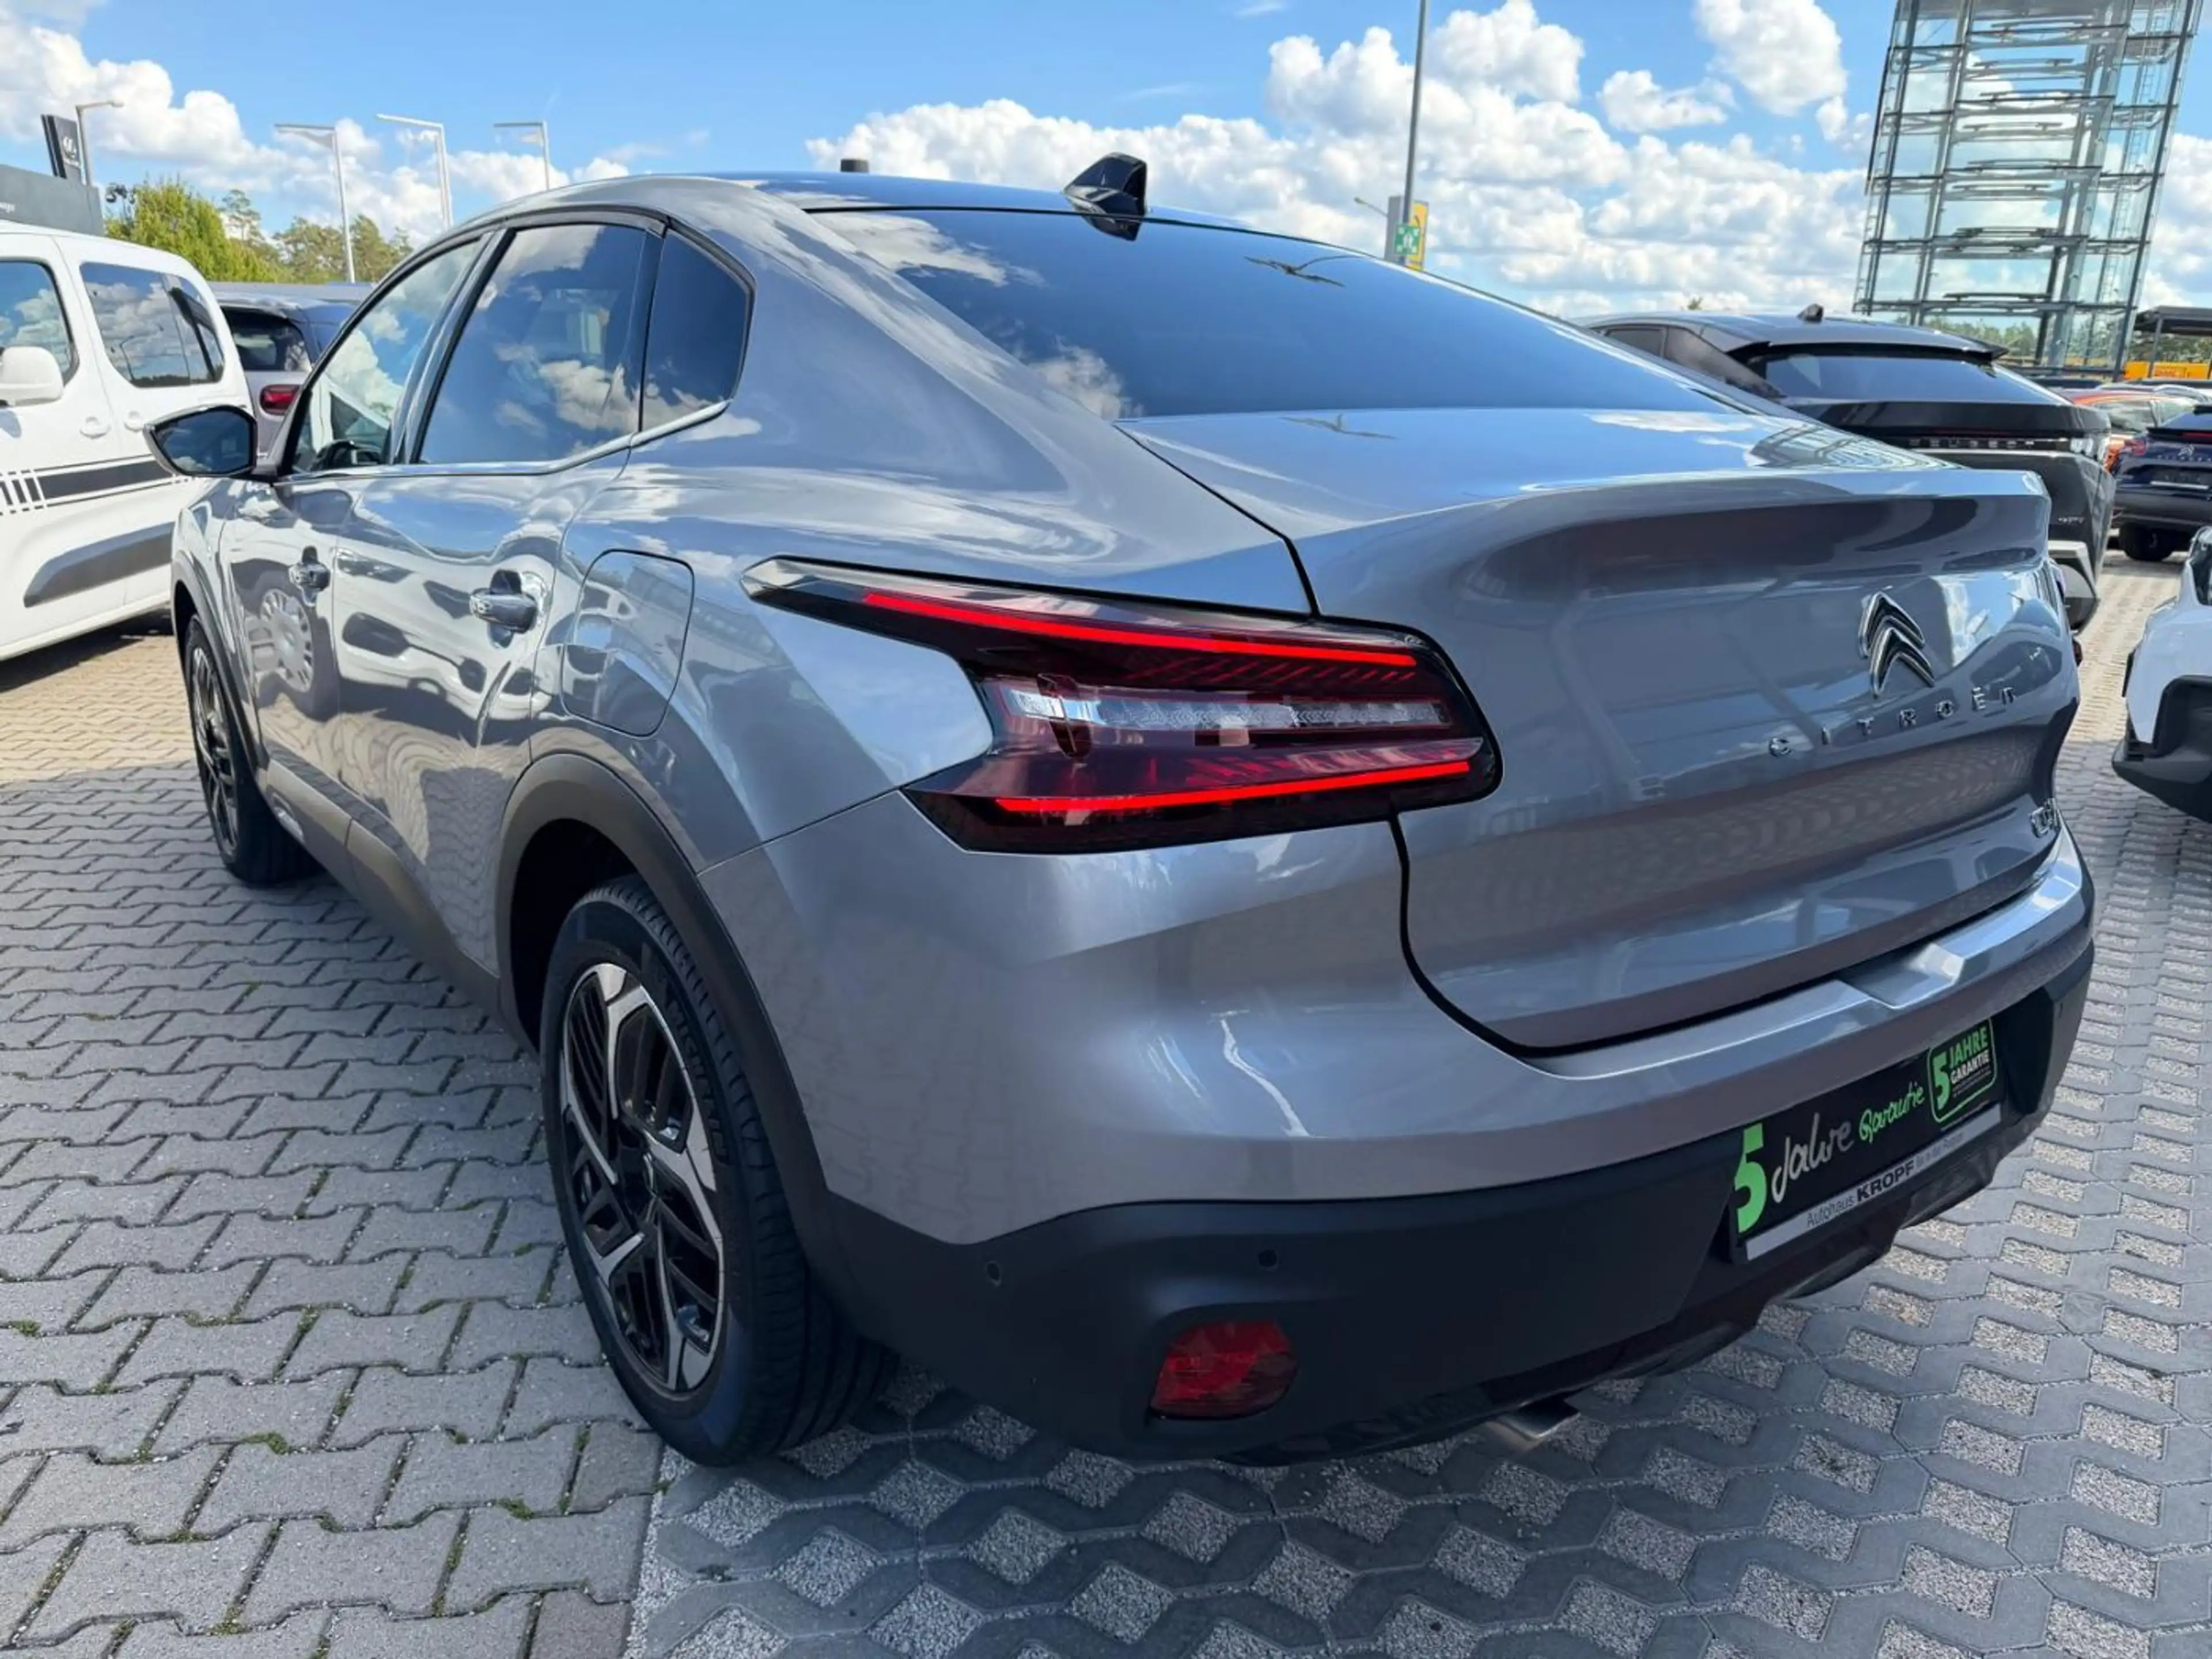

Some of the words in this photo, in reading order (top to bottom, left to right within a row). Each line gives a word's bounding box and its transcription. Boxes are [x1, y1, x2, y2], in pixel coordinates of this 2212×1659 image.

[1949, 1026, 1988, 1069] JAHRE
[1933, 1051, 1951, 1110] 5
[1734, 1123, 1767, 1233] 5
[1771, 1112, 1855, 1203] Jahre
[1856, 1160, 1914, 1202] KROPF
